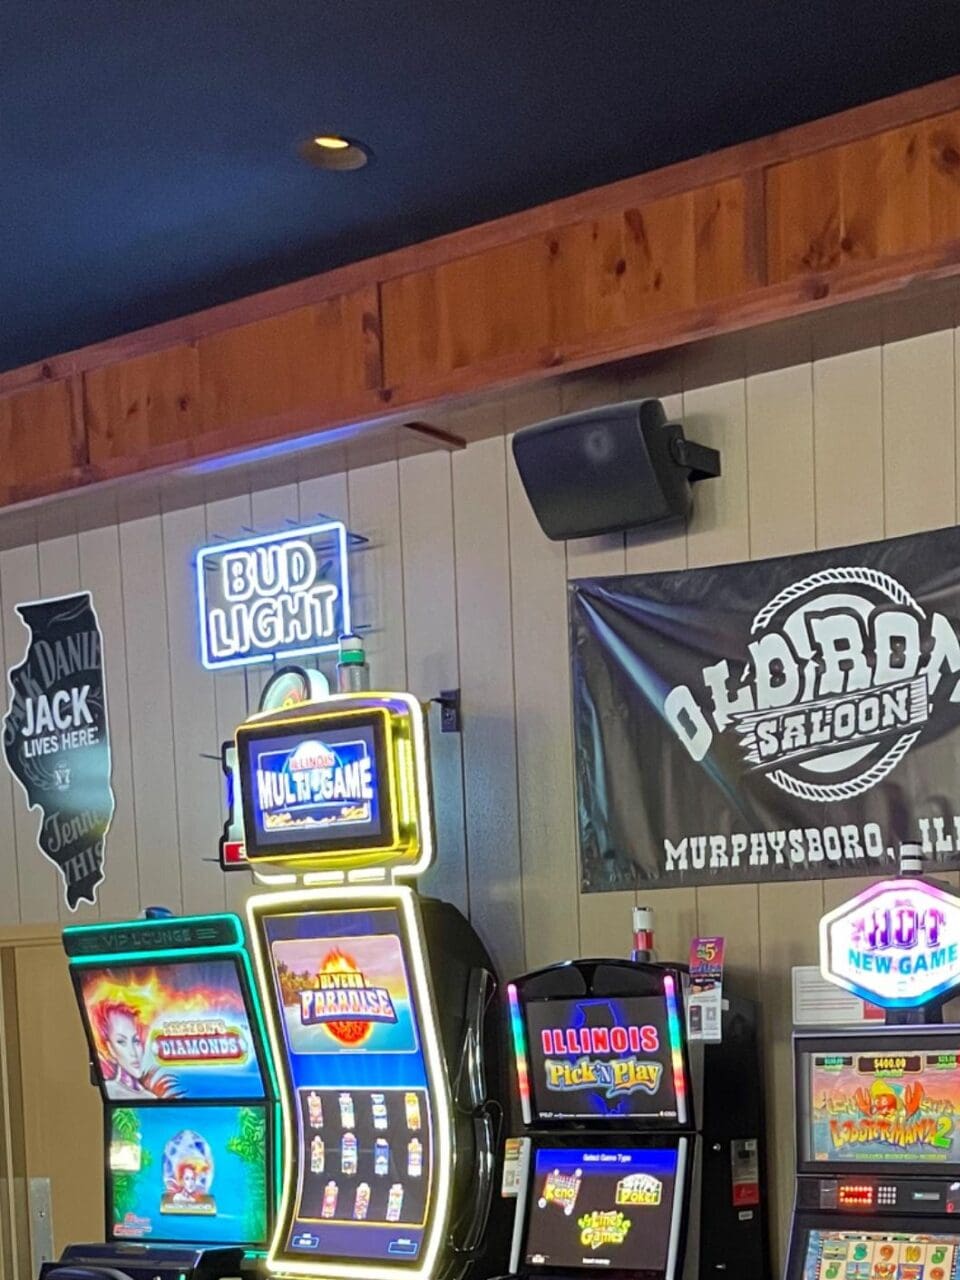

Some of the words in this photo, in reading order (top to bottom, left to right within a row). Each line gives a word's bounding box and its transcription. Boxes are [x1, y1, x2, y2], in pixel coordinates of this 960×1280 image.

[222, 540, 317, 600] BUD
[210, 584, 338, 657] LIGHT
[22, 685, 94, 736] JACK
[664, 632, 800, 761] OLD
[755, 688, 913, 758] SALOON
[24, 736, 59, 758] LIVES
[321, 756, 373, 803] GAME
[663, 822, 896, 872] MURPHYSBORO,
[102, 934, 128, 947] VIP
[131, 927, 193, 944] LOUNGE
[848, 948, 893, 974] NEW
[898, 943, 959, 975] GAME
[300, 988, 396, 1020] PARADISE
[161, 1037, 240, 1057] DIAMONDS
[541, 1025, 660, 1055] ILLINOIS
[548, 1058, 596, 1086] Pick
[933, 1115, 954, 1149] 2
[545, 1184, 575, 1202] Keno
[620, 1188, 658, 1205] Poker
